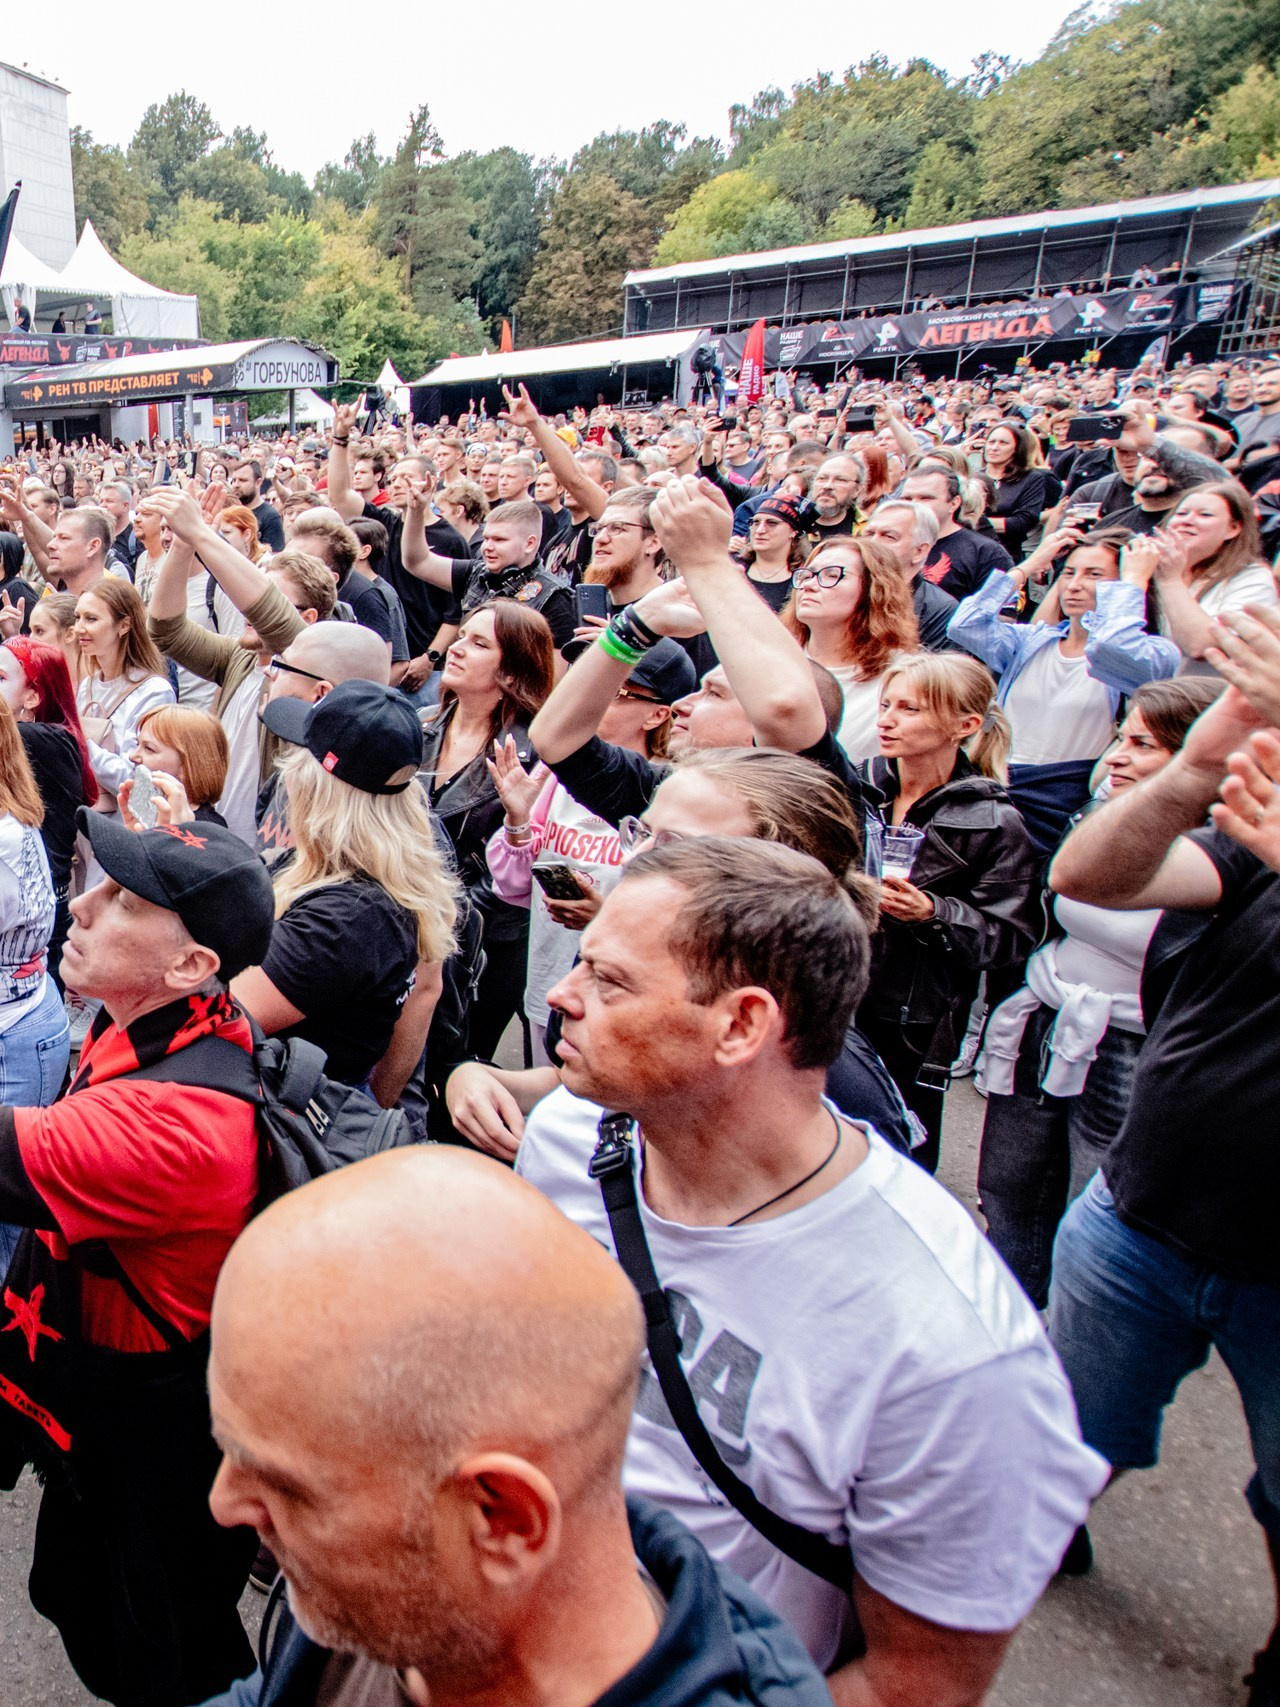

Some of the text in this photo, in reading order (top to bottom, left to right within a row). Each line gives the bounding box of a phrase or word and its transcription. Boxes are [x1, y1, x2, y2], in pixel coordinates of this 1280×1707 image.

[928, 306, 1050, 325] МОСКОВСКИЙ РОК-ФЕСТИВАЛЬ
[780, 330, 804, 340] НАШЕ
[920, 315, 1055, 347] ЛЕГЕНДА
[0, 346, 50, 362] ЛЕГЕНДА
[87, 346, 101, 356] НАШЕ
[253, 361, 322, 384] ГОРБУНОВА
[739, 358, 753, 395] НАШЕ
[48, 384, 71, 397] РЕН
[72, 382, 87, 395] ТВ
[88, 371, 180, 394] ПРЕДСТАВЛЯЕТ
